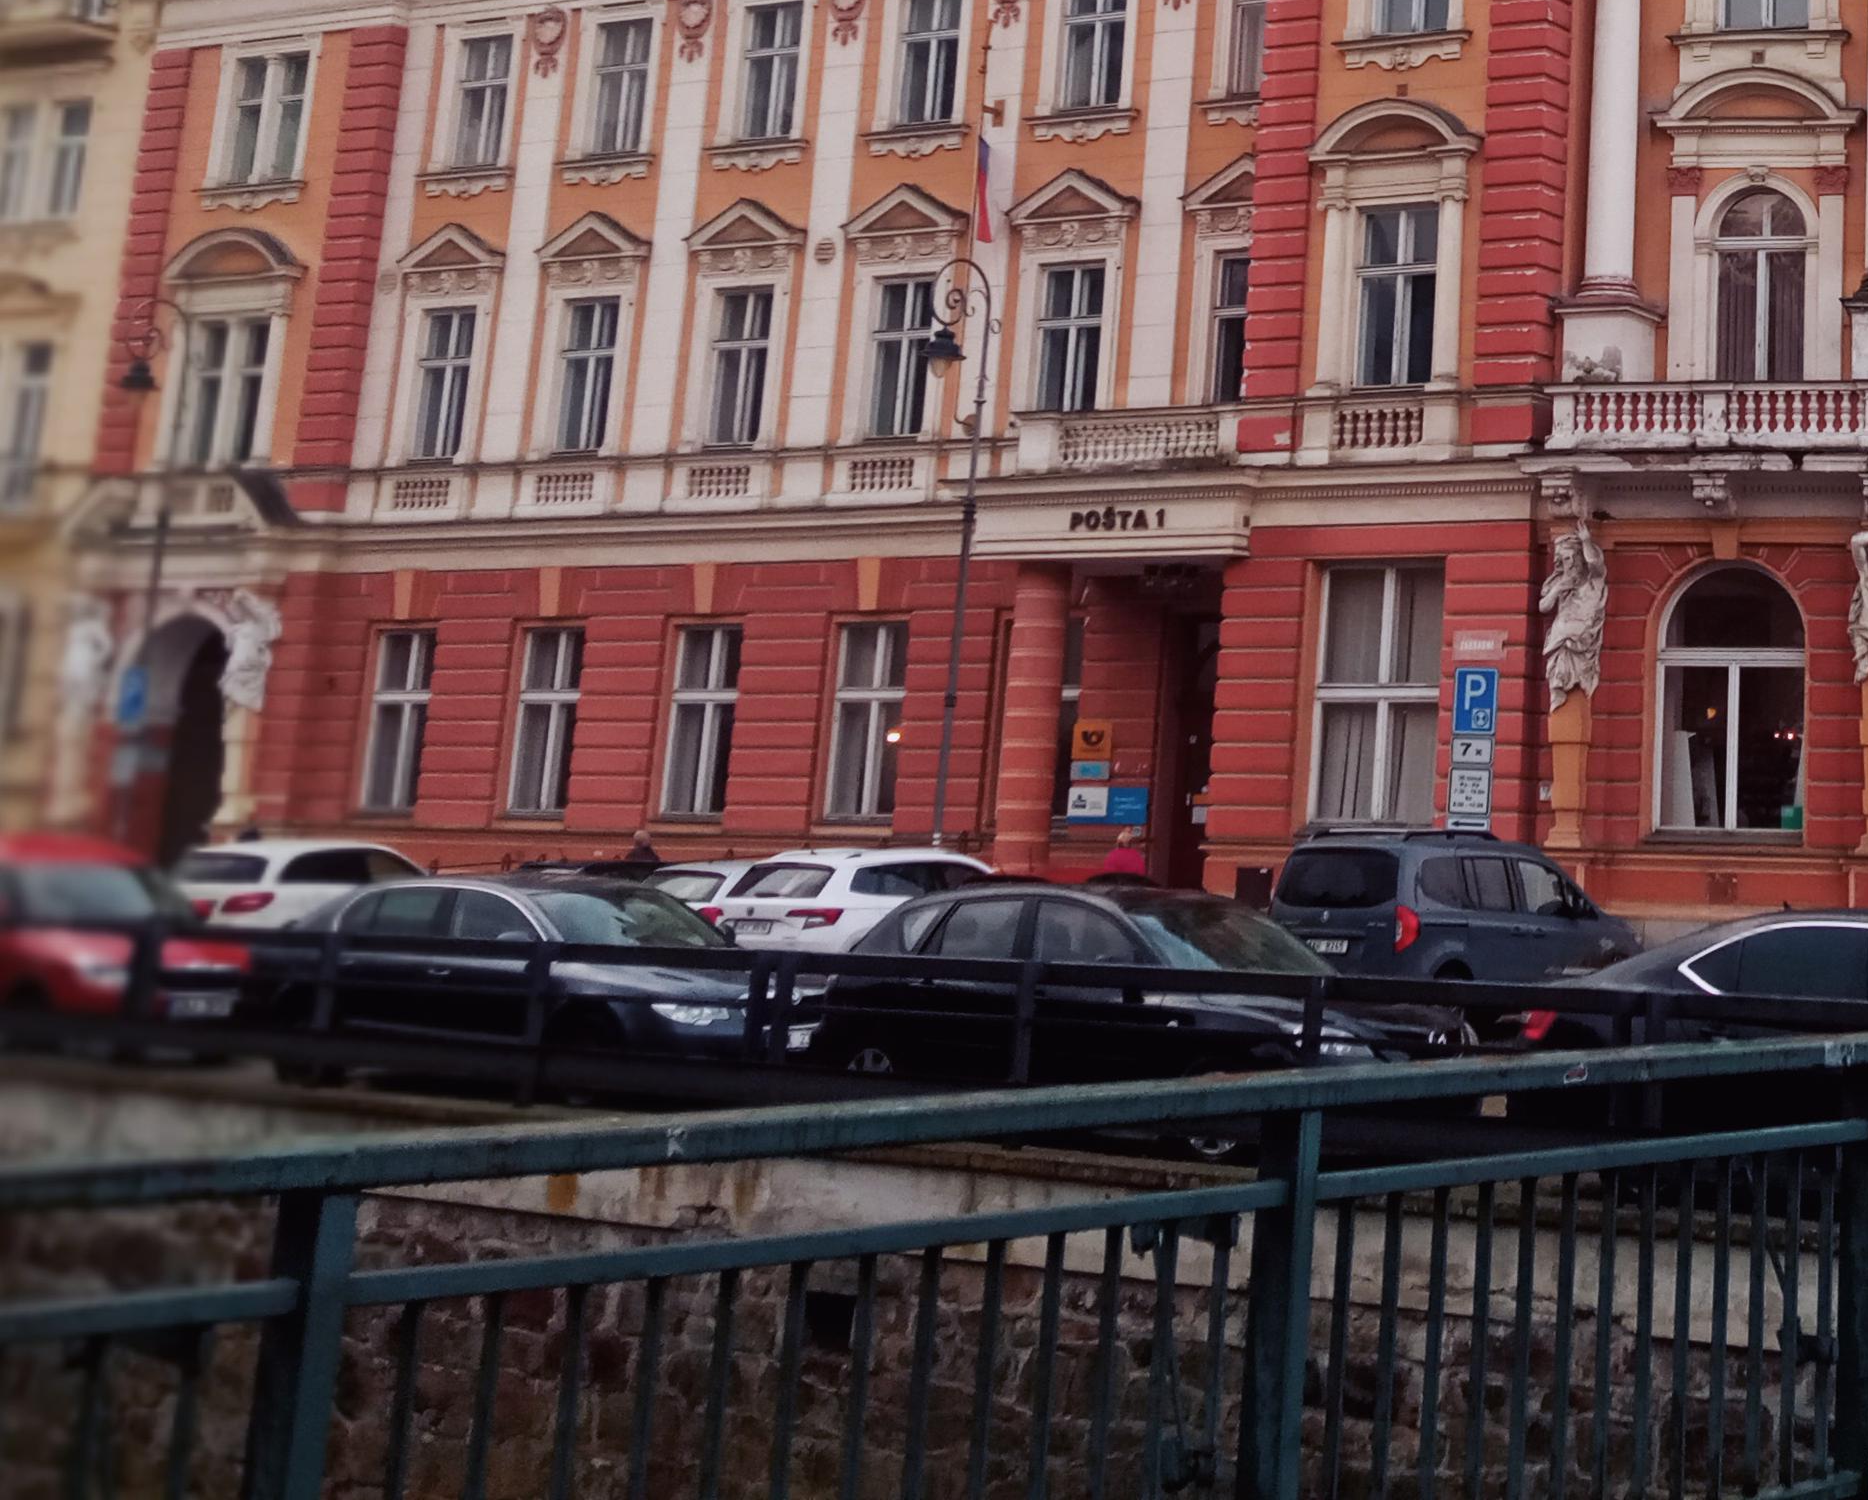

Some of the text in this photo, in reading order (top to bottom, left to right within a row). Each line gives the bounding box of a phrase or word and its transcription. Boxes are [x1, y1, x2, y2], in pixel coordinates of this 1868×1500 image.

[1069, 506, 1165, 531] POŠTA 1
[1464, 674, 1487, 710] P
